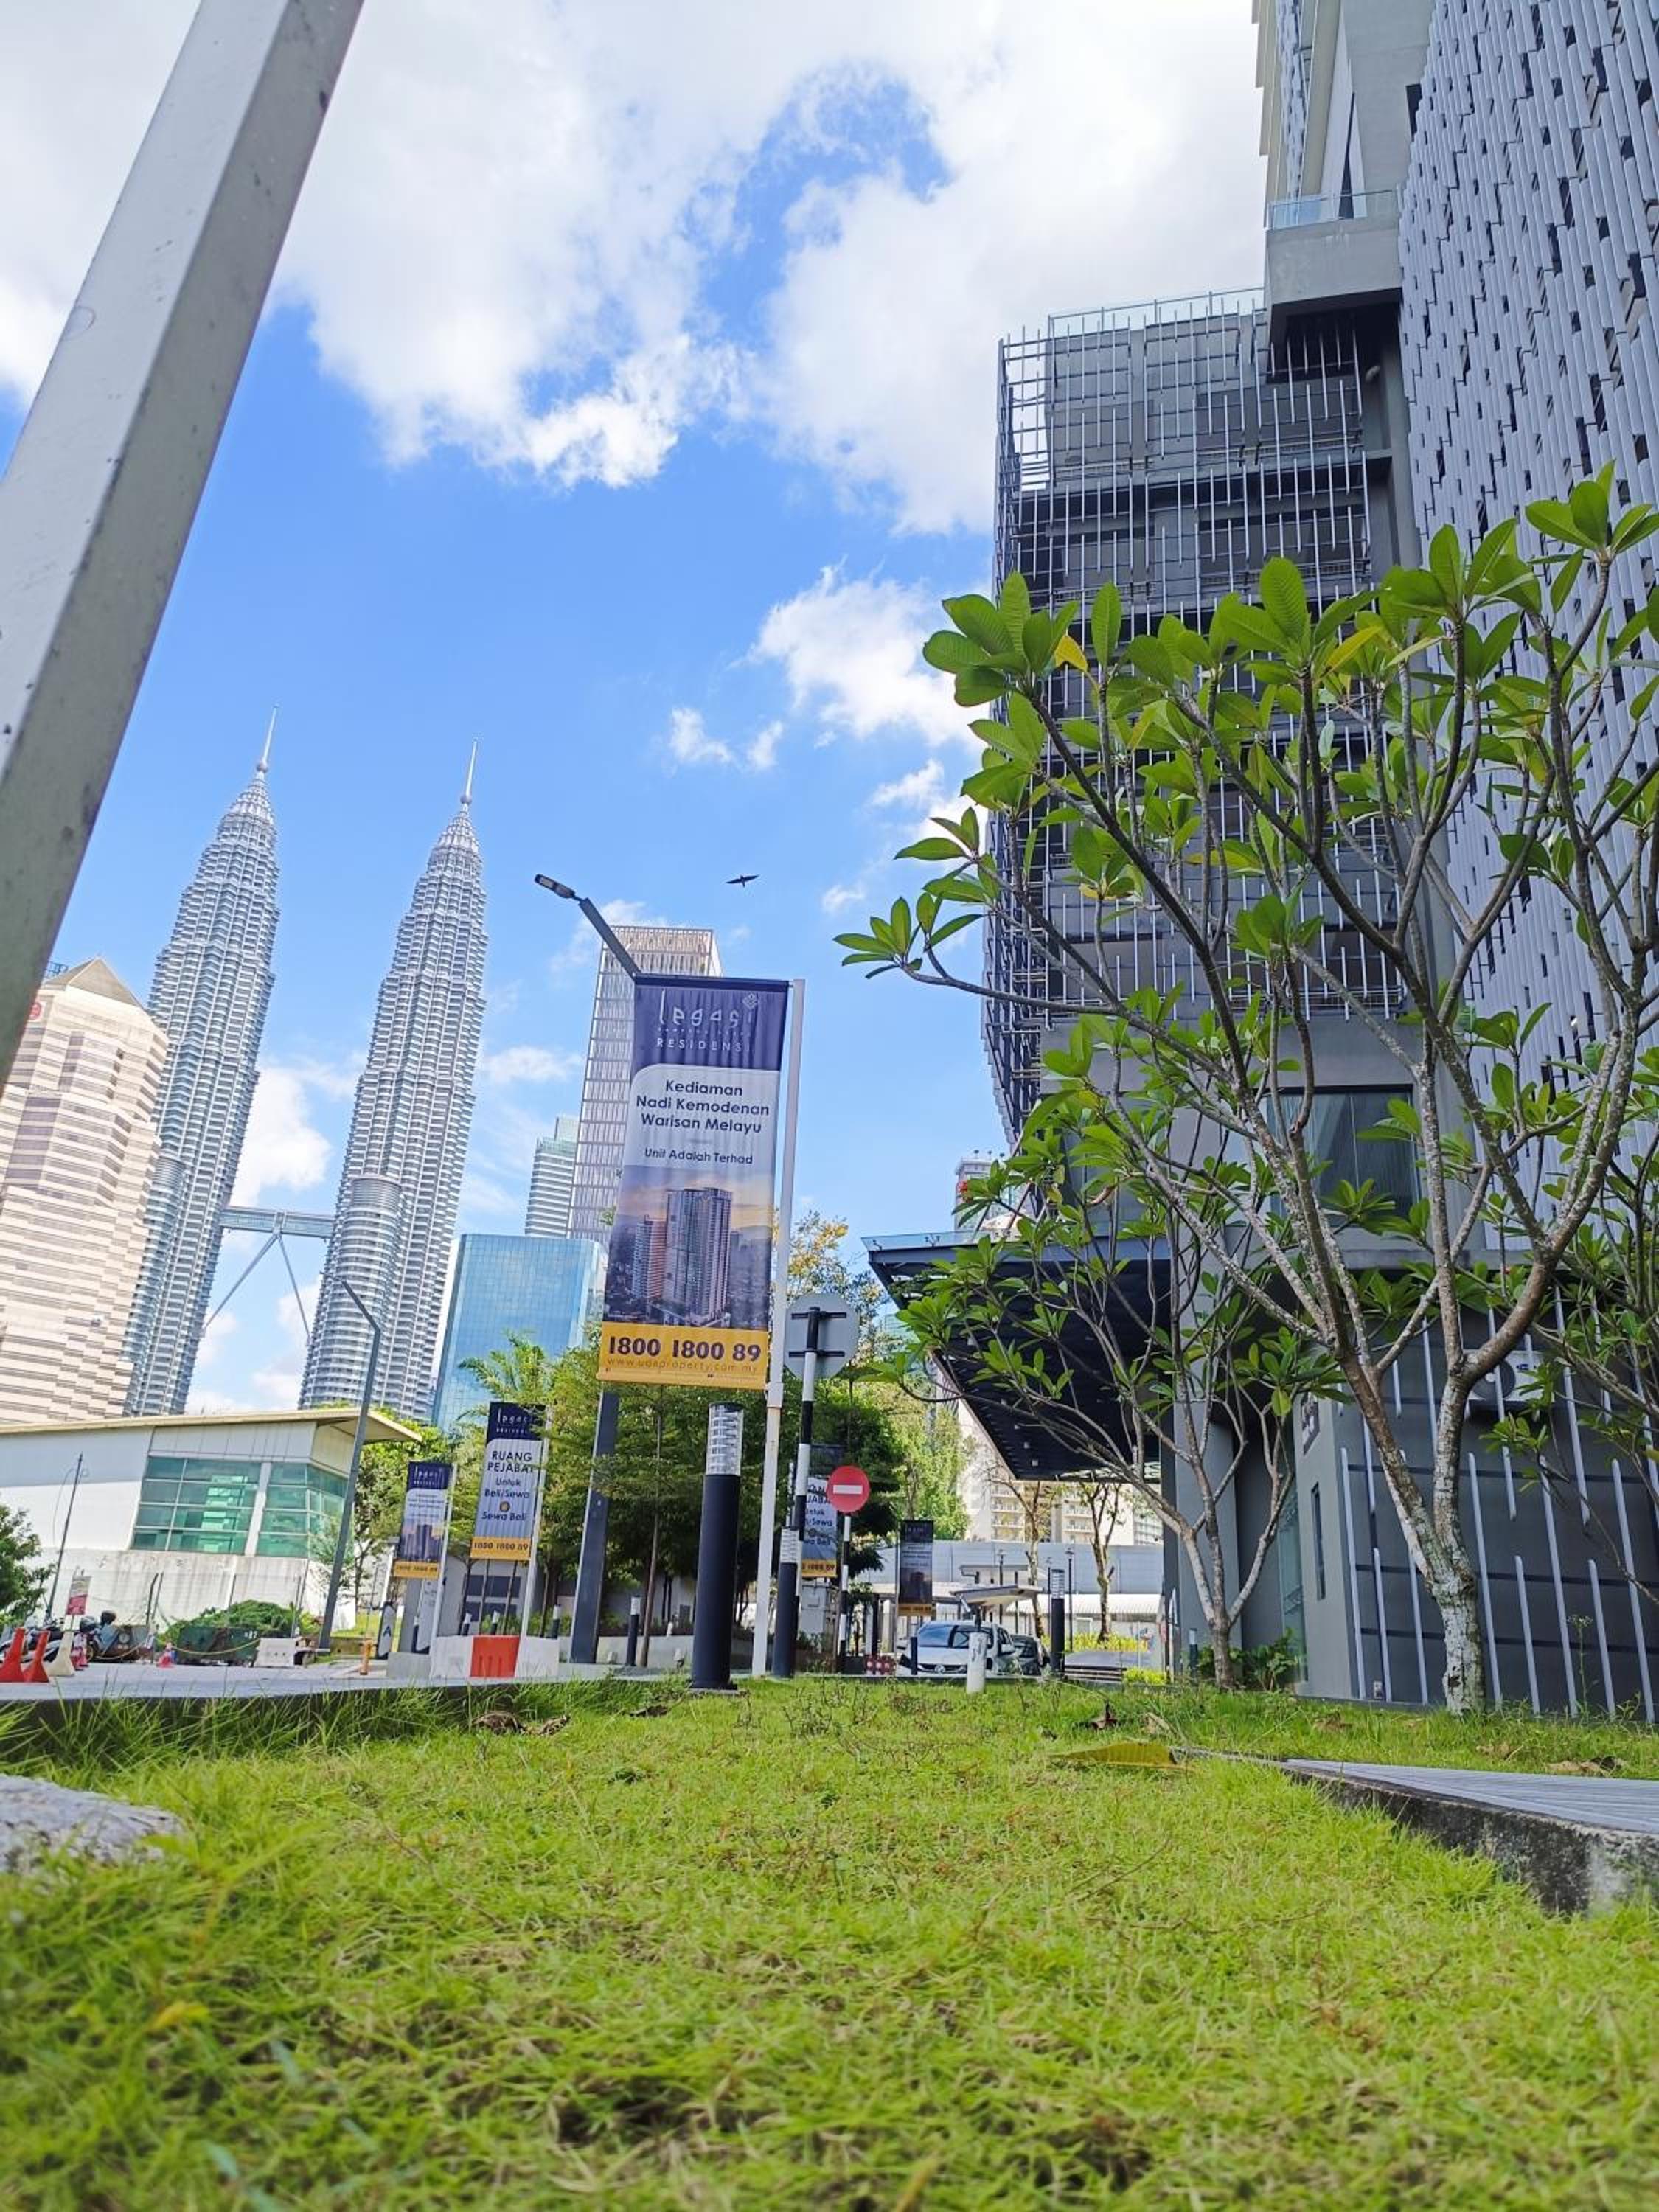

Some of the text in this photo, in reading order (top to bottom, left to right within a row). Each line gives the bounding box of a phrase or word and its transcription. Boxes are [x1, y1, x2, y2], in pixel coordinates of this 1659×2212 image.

[657, 1037, 750, 1052] RESIDENSI
[666, 1079, 742, 1096] Kediaman
[636, 1096, 769, 1116] Nadi Kemodenan
[641, 1113, 762, 1135] Warisan Melayu
[644, 1147, 753, 1164] Unit Adalah Terhad
[609, 1336, 762, 1362] 1800 1800 89
[492, 1450, 532, 1462] RUANG
[495, 1477, 521, 1486] Untuk
[484, 1488, 530, 1498] Beli/Sewa
[481, 1512, 507, 1520] Sewa
